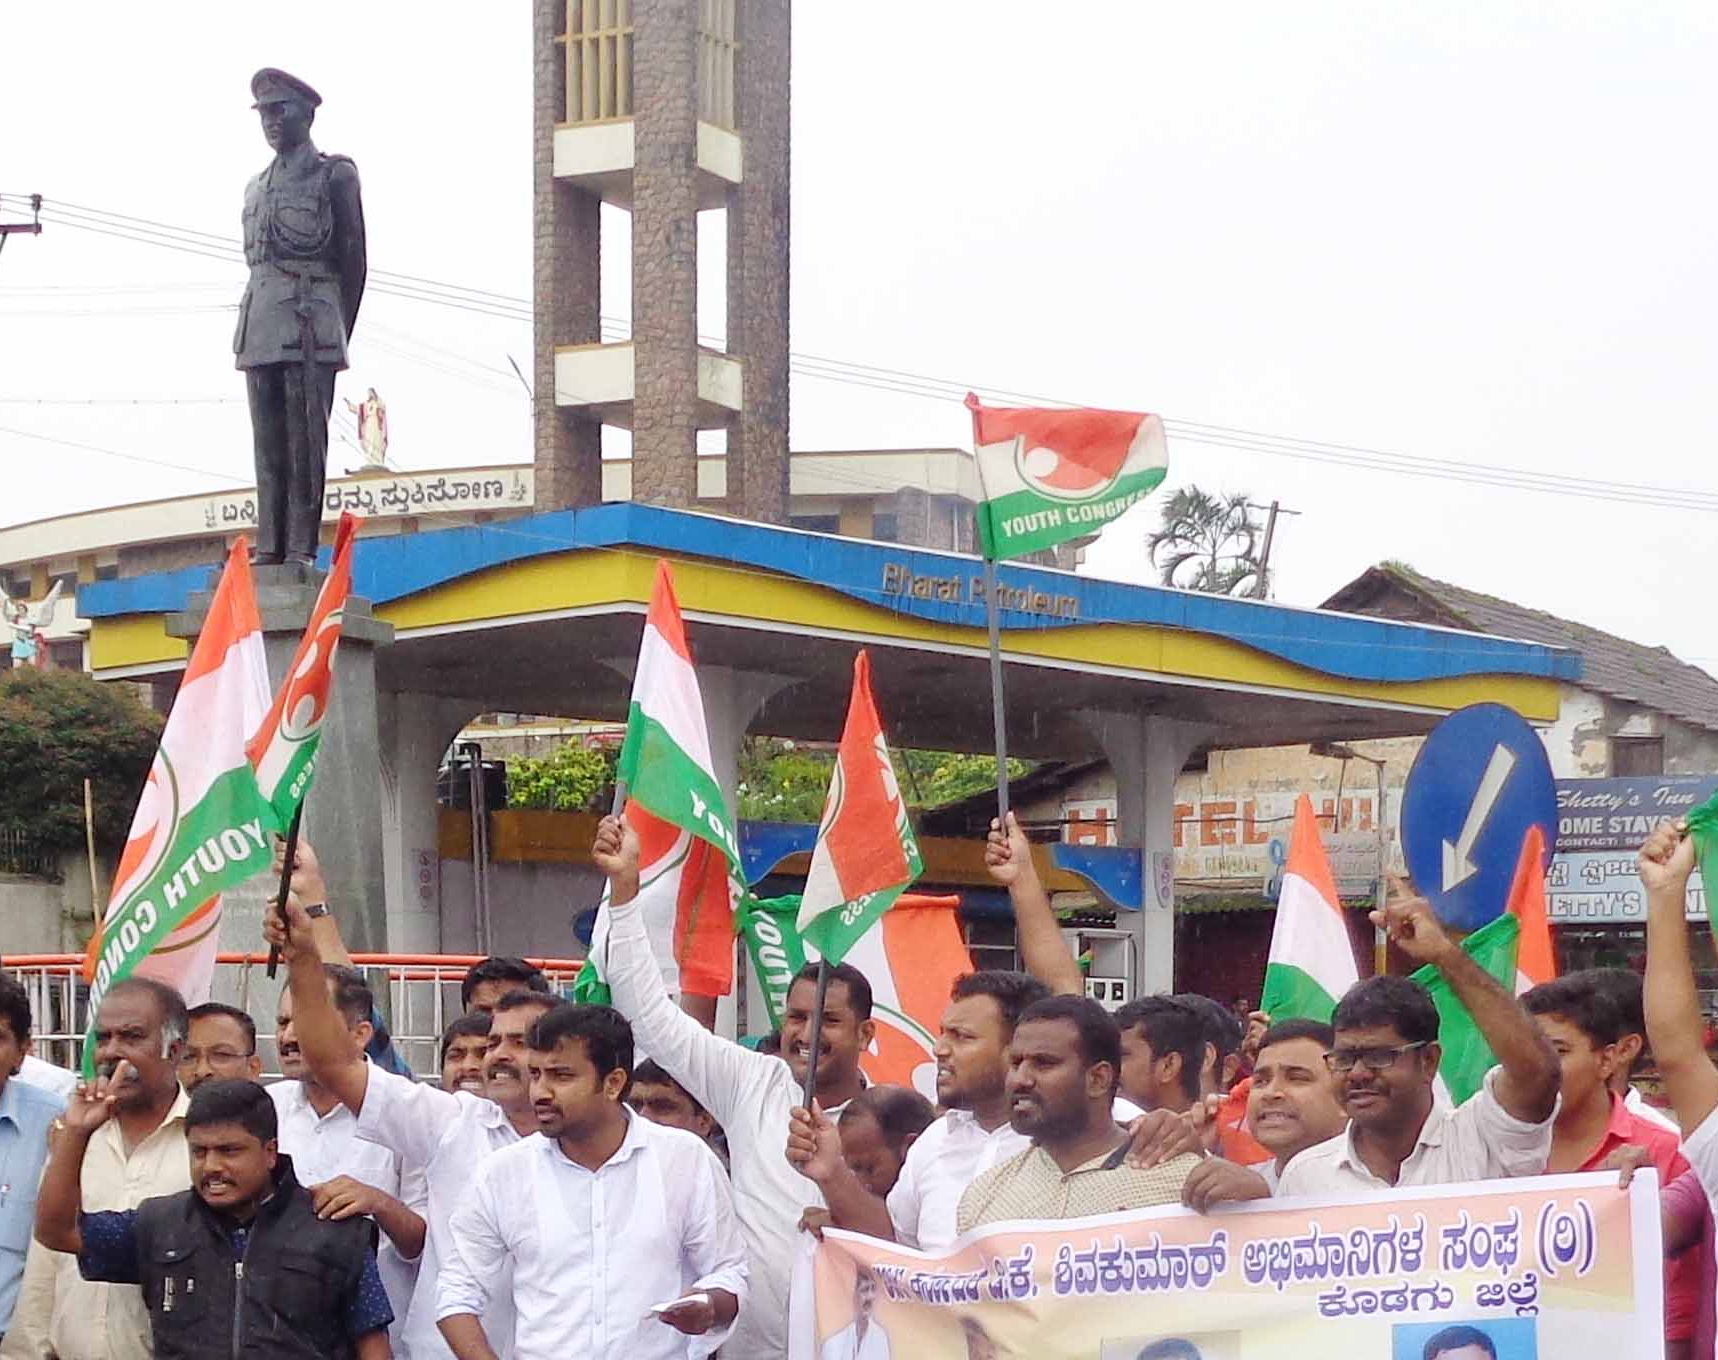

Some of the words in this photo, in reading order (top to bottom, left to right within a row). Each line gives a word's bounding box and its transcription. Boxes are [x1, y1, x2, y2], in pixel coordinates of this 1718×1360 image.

[1001, 508, 1064, 538] YOUTH
[883, 562, 962, 603] Bharat
[969, 574, 1079, 617] Ptroleum
[1555, 787, 1642, 811] Shetty's
[1652, 785, 1695, 807] Inn
[1068, 800, 1269, 848] HTEL
[1558, 816, 1604, 835] OME
[1545, 890, 1642, 918] ETTY'S
[1054, 1230, 1228, 1296] ಶಿವಕುಮಾರ್
[1243, 1214, 1425, 1291] ಅಭಿಮಾನಿಗಳ
[1442, 1209, 1521, 1276] ಸಂಘ
[1538, 1200, 1595, 1276] (ರಿ)
[1319, 1280, 1455, 1318] ಕೊಡಗು
[1476, 1272, 1540, 1317] ಜಿಲ್ಲೆ
